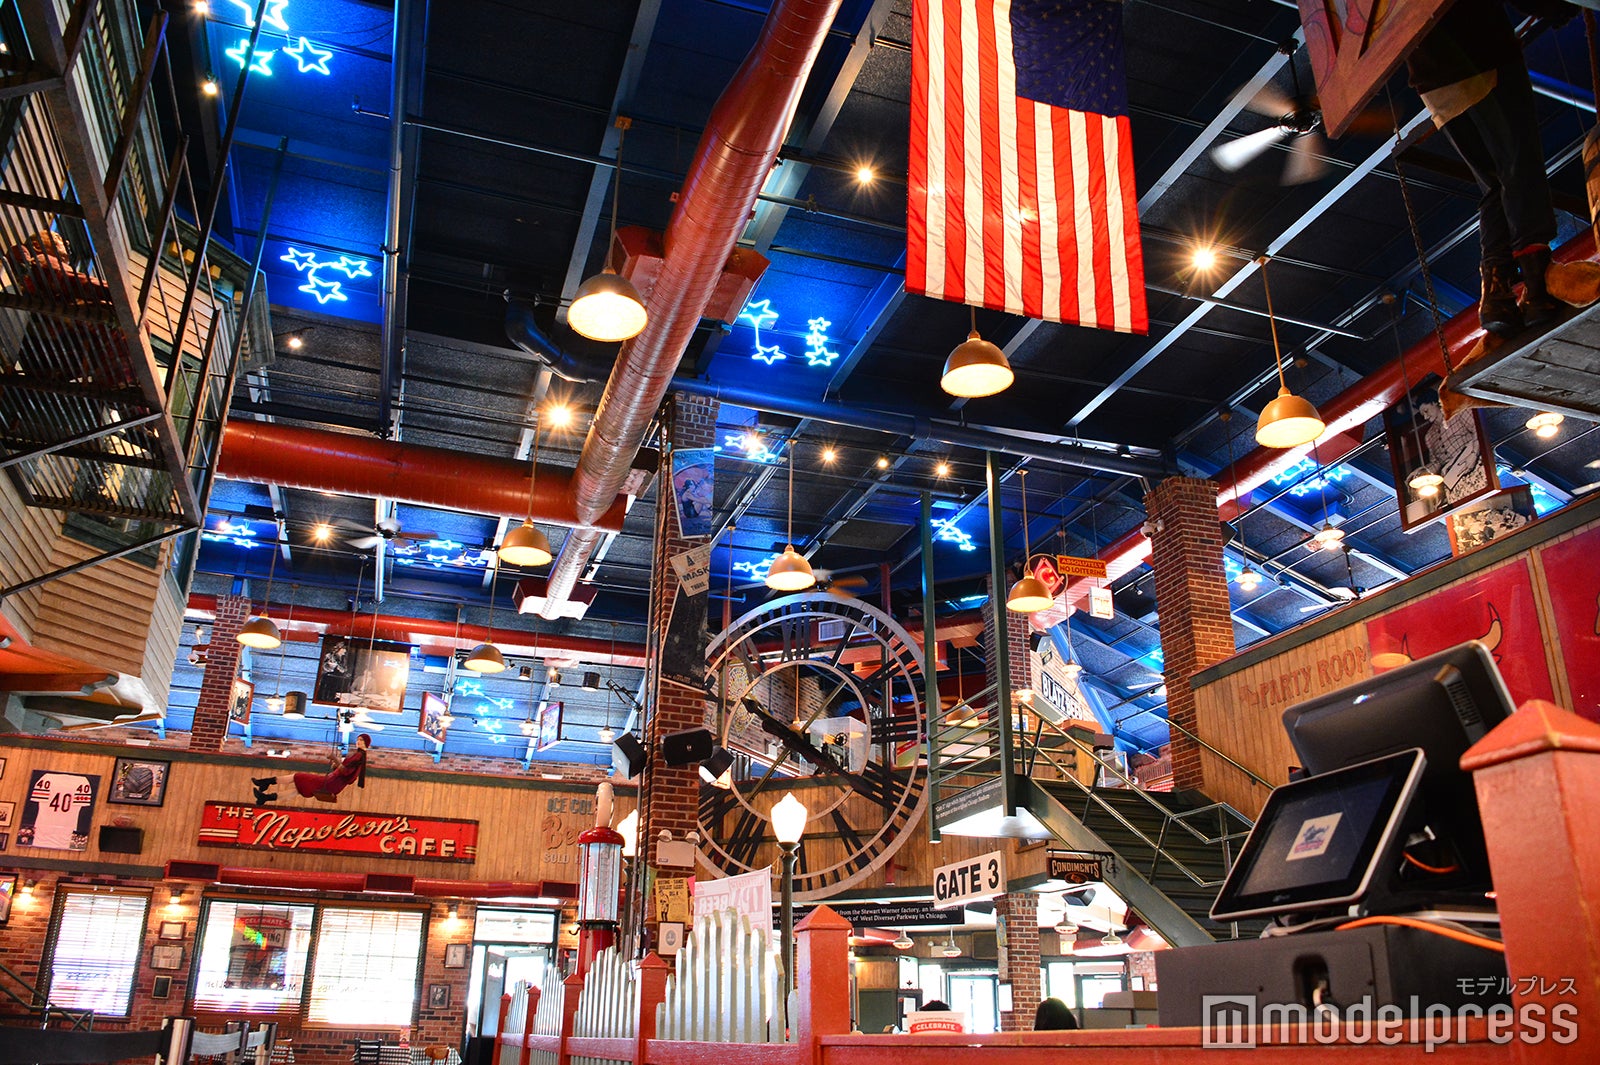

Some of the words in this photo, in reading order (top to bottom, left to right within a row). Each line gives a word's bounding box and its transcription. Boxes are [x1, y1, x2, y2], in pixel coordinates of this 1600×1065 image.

[1061, 558, 1103, 568] ABSOLUTELY
[1060, 564, 1071, 572] NO
[1071, 566, 1106, 577] LOITERING
[1259, 664, 1312, 709] PARTY
[36, 779, 51, 790] 40
[76, 784, 90, 794] 40
[50, 792, 72, 813] 40
[547, 797, 569, 814] ICE
[571, 798, 595, 816] COL
[215, 805, 254, 819] THE
[251, 810, 415, 848] Napoleon's
[379, 835, 455, 857] CAFE
[543, 852, 571, 865] SOLD
[1051, 859, 1100, 879] CONDIMENTS
[936, 862, 982, 901] GATE
[987, 858, 999, 889] 3
[861, 907, 880, 915] Stewart
[874, 914, 896, 922] Diversey
[896, 913, 918, 921] Parkway
[916, 1023, 956, 1031] CELEBRATE
